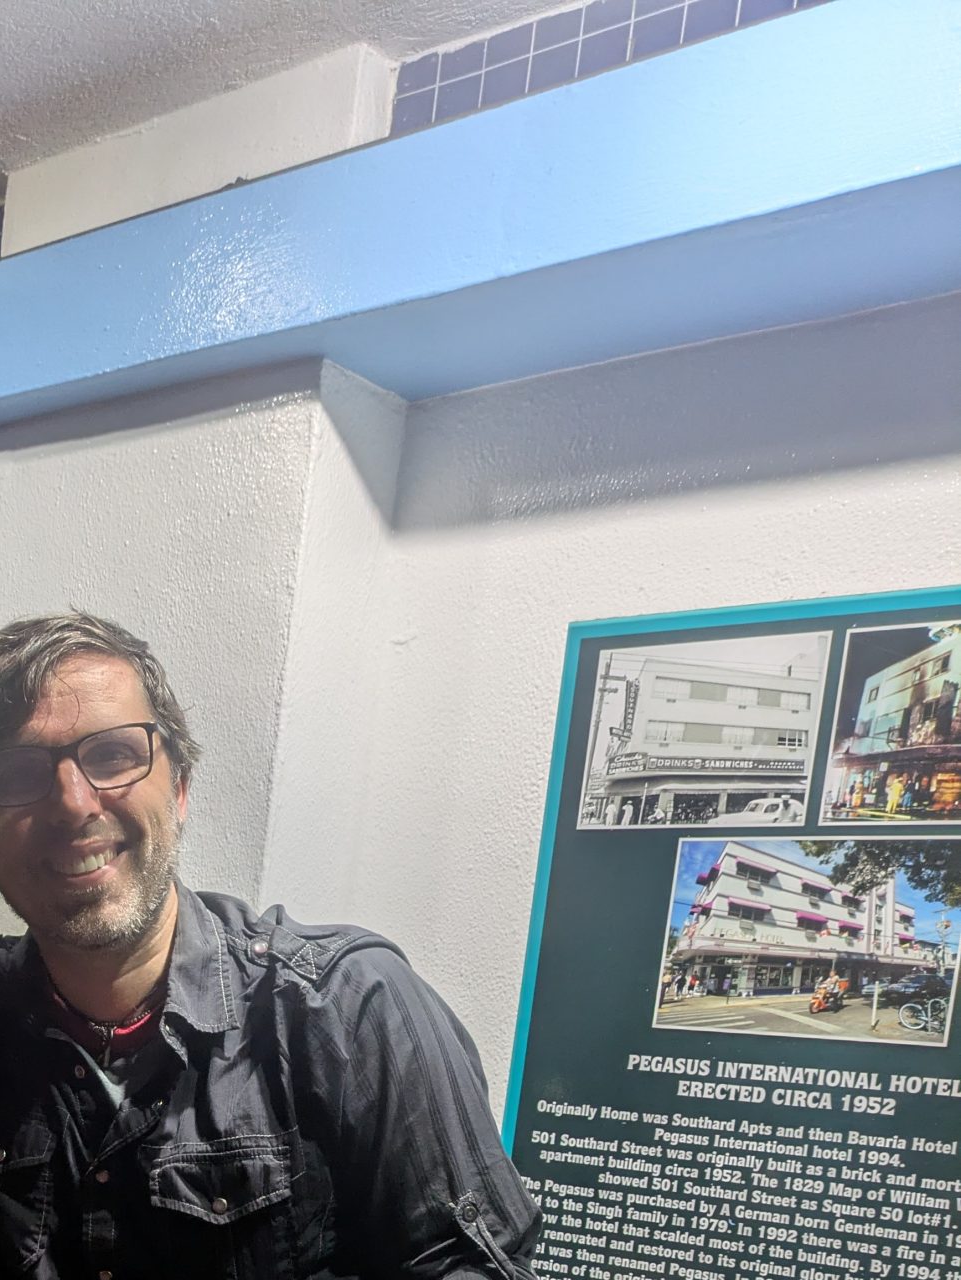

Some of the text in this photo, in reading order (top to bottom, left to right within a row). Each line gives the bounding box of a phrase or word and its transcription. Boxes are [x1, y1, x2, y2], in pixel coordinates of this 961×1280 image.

[658, 759, 694, 767] DRINKS
[704, 760, 754, 768] SANDWICHES
[626, 1054, 961, 1097] PEGASUS INTERNATIONAL HOTEL
[676, 1080, 896, 1116] ERECTED CIRCA 1952
[536, 1099, 957, 1155] Originally Home was Southard Apts and then Bavaria Hotel
[653, 1127, 905, 1168] Pegasus International hotel 1994.
[531, 1130, 556, 1145] 501
[559, 1133, 618, 1152] Southard
[621, 1140, 663, 1157] Street
[666, 1148, 693, 1161] was
[696, 1150, 764, 1172] originally
[766, 1157, 803, 1174] built
[805, 1164, 823, 1176] as
[826, 1167, 837, 1178] a
[840, 1165, 882, 1183] brick
[885, 1173, 916, 1187] and
[539, 1150, 605, 1167] apartment
[607, 1155, 662, 1177] building
[664, 1163, 699, 1178] circa
[704, 1167, 746, 1184] 1952.
[750, 1172, 778, 1188] The
[783, 1176, 824, 1194] 1829
[828, 1182, 862, 1202] Map
[866, 1188, 886, 1201] of
[890, 1189, 950, 1210] William
[543, 1179, 595, 1197] Pegasus
[598, 1189, 623, 1201] was
[626, 1193, 696, 1211] purchased
[699, 1200, 717, 1217] by
[719, 1203, 730, 1216] A
[734, 1205, 790, 1224] German
[794, 1213, 829, 1230] born
[834, 1218, 918, 1242] Gentleman
[922, 1230, 938, 1245] in
[598, 1171, 648, 1188] showed
[651, 1177, 678, 1192] 501
[683, 1181, 748, 1202] Southard
[750, 1189, 797, 1208] Street
[800, 1199, 818, 1211] as
[821, 1199, 876, 1218] Square
[879, 1206, 903, 1222] 50
[543, 1229, 607, 1247] renovated
[609, 1239, 634, 1252] and
[637, 1244, 694, 1262] restored
[697, 1251, 713, 1264] to
[717, 1253, 736, 1268] its
[739, 1259, 796, 1277] original
[545, 1196, 559, 1208] to
[562, 1198, 583, 1212] the
[586, 1201, 622, 1220] Singh
[626, 1207, 669, 1227] family
[671, 1213, 685, 1227] in
[690, 1215, 732, 1234] 1979.
[736, 1222, 752, 1237] In
[758, 1225, 798, 1243] 1992
[801, 1232, 842, 1249] there
[846, 1240, 877, 1254] was
[881, 1245, 891, 1256] a
[896, 1245, 925, 1261] fire
[929, 1249, 946, 1264] in
[561, 1214, 582, 1228] the
[585, 1217, 619, 1233] hotel
[622, 1223, 650, 1238] that
[653, 1229, 705, 1246] scalded
[708, 1238, 745, 1252] most
[748, 1242, 766, 1255] of
[768, 1244, 793, 1259] the
[797, 1248, 864, 1273] building.
[869, 1259, 892, 1277] By
[530, 1258, 568, 1274] ersion
[571, 1264, 587, 1276] of
[588, 1266, 611, 1280] the
[548, 1245, 573, 1258] was
[575, 1248, 605, 1264] then
[608, 1256, 665, 1273] renamed
